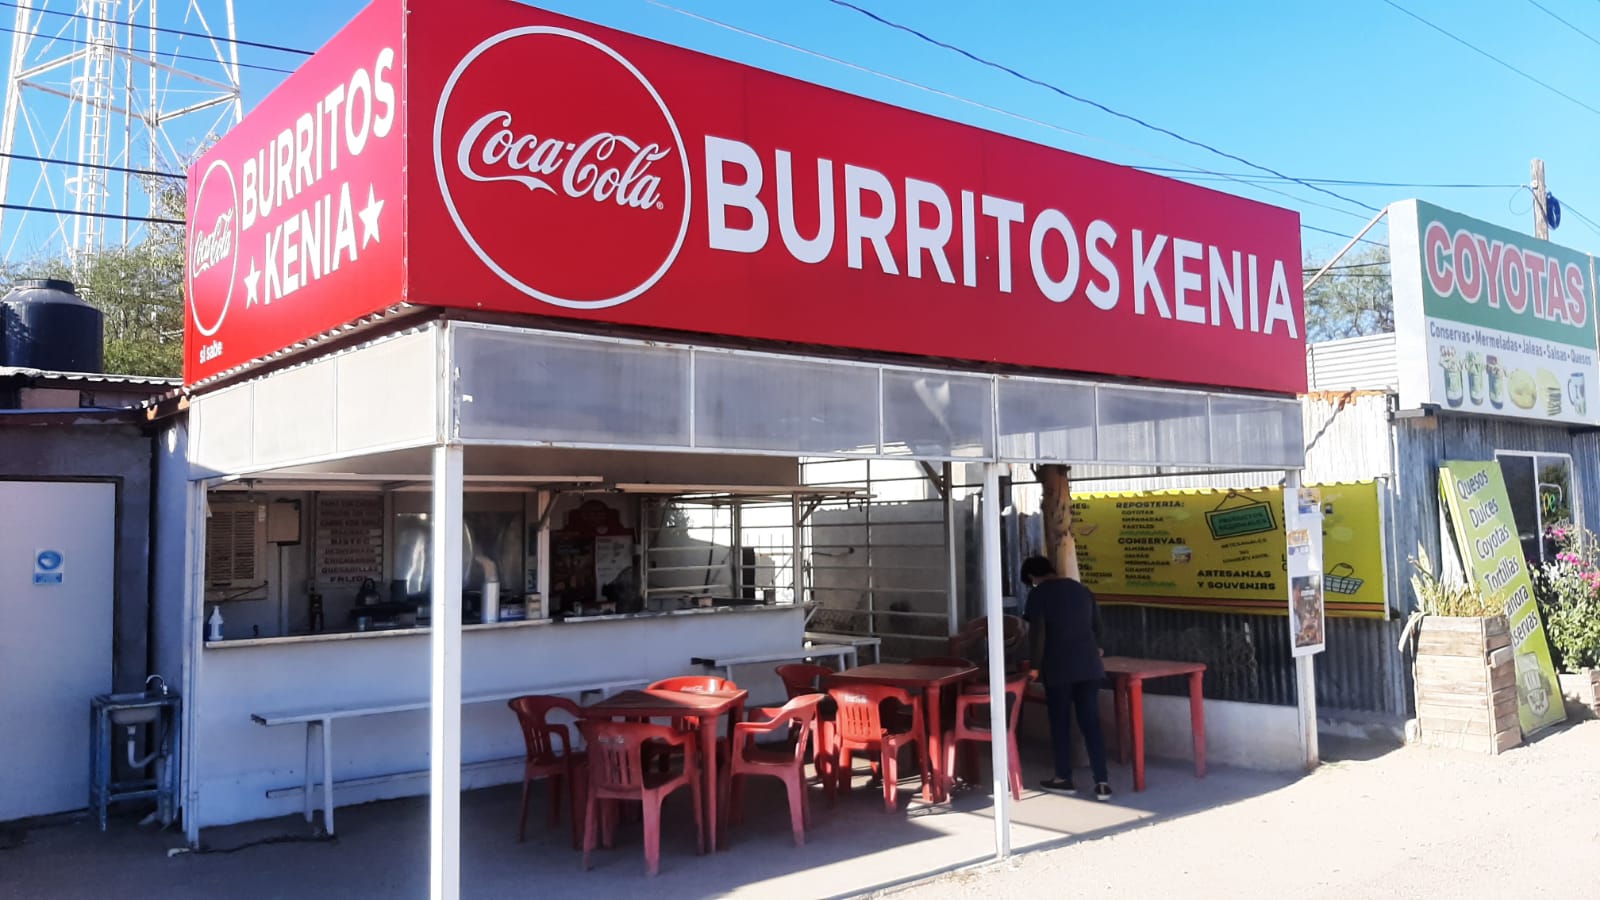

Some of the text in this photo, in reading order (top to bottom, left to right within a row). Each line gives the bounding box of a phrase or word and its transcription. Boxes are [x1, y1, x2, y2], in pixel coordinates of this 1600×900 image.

[242, 47, 395, 231] BURRITOS
[457, 110, 671, 209] Coca-Cola
[193, 208, 233, 278] Coca-Cola
[264, 182, 358, 305] KENIA
[704, 135, 1298, 339] BURRITOS KENIA
[1425, 221, 1587, 328] COYOTAS
[1430, 321, 1592, 366] Conservas Mermeladas Jaleas Salsas Quesos
[1457, 469, 1488, 500] Quesos
[1469, 497, 1498, 528] Dulces
[1476, 523, 1510, 559] Coyotas
[1207, 581, 1276, 590] SOUVENIRS
[1484, 555, 1519, 593] Tortillas
[1511, 611, 1538, 648] servas
